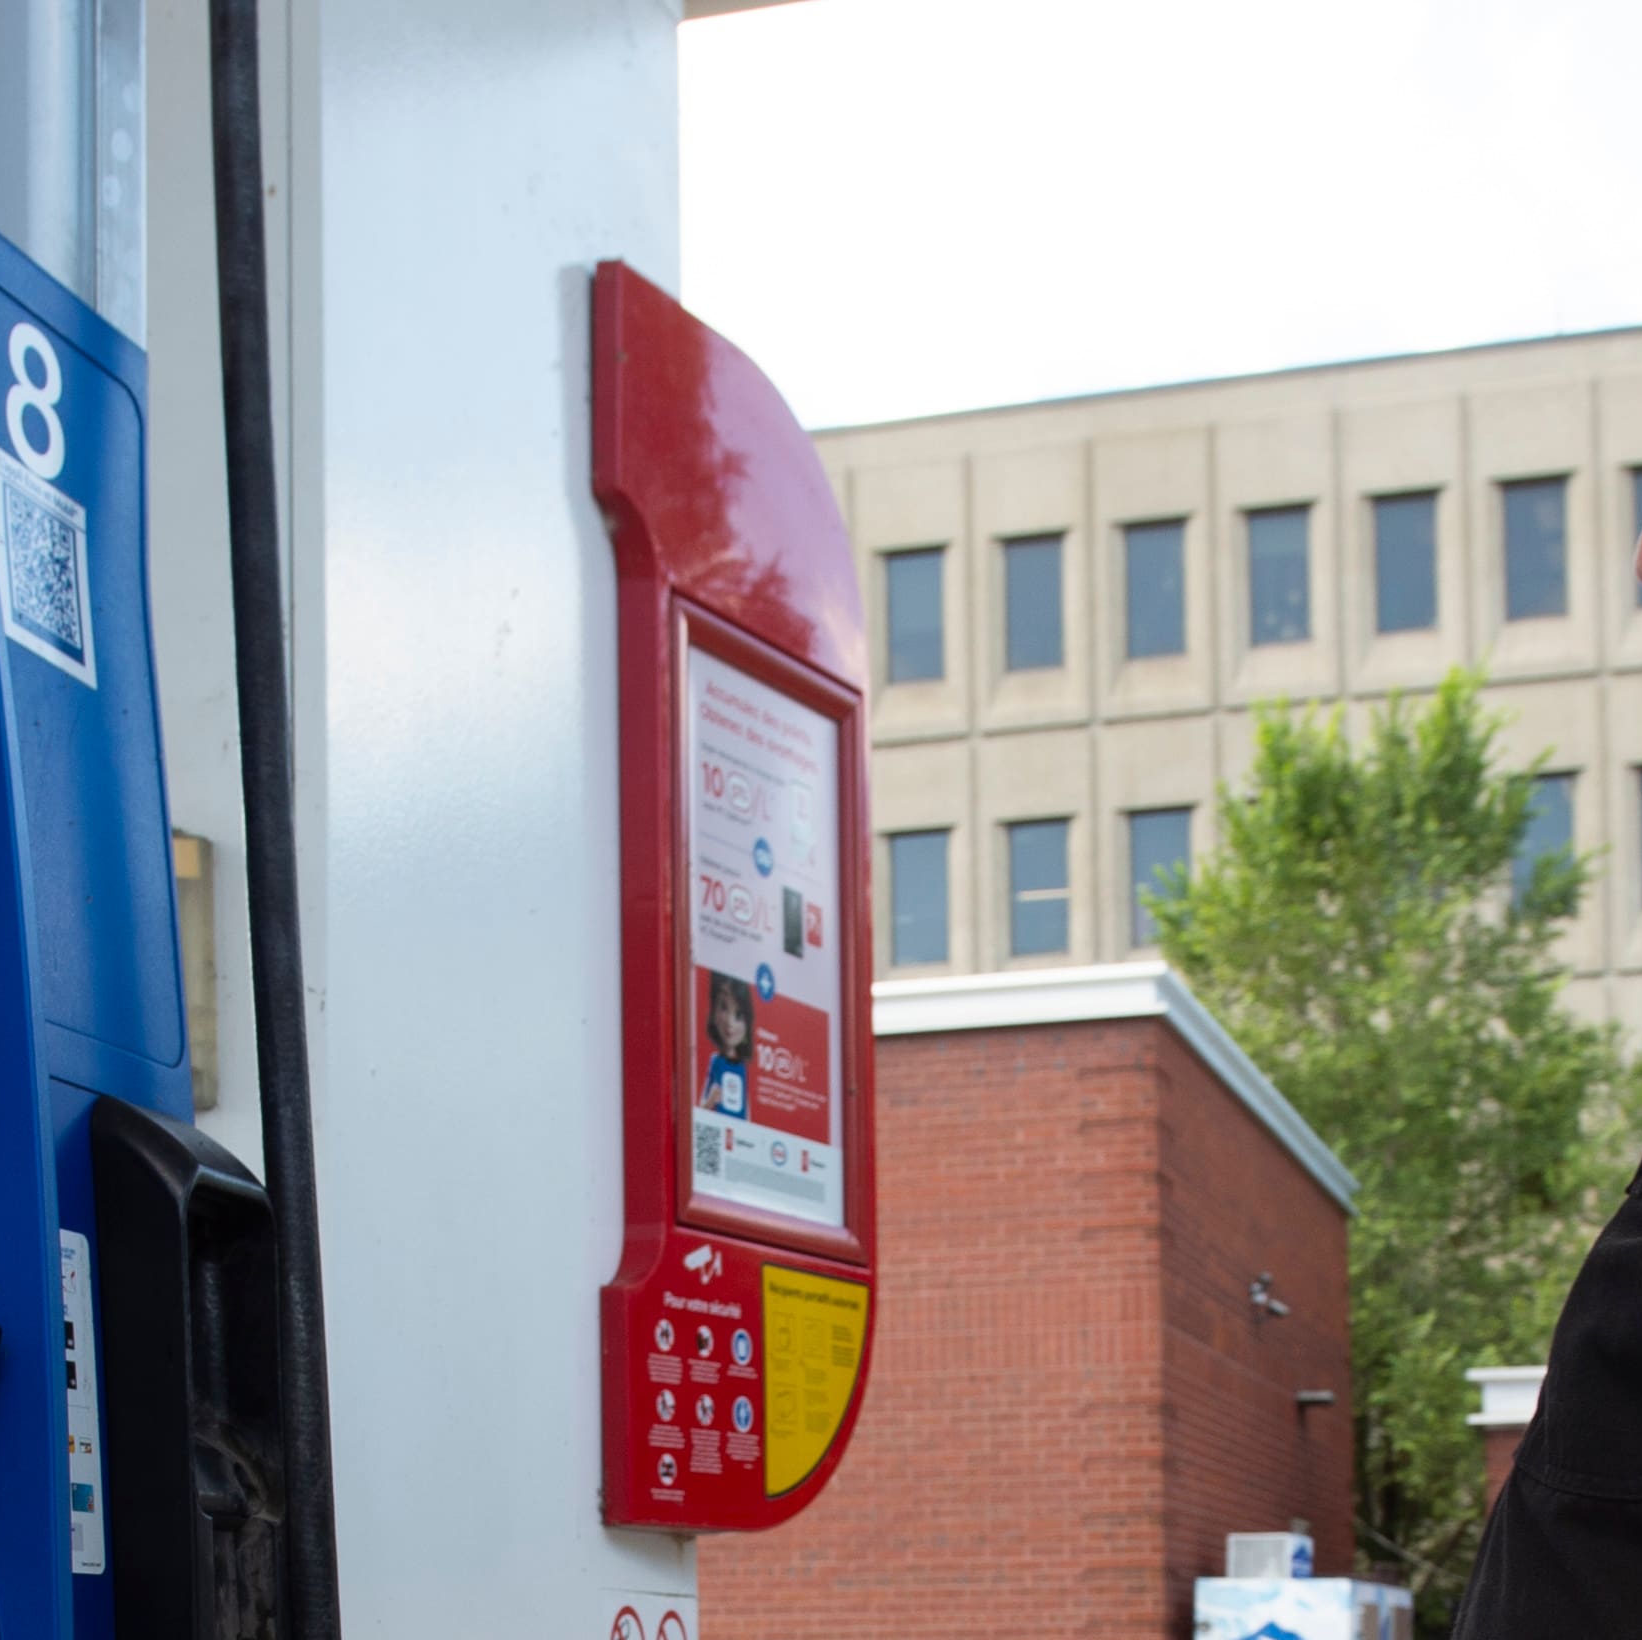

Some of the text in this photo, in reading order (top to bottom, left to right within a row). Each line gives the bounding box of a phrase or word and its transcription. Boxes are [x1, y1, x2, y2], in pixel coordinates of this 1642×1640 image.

[4, 321, 66, 481] 8
[701, 761, 724, 798] 10
[699, 873, 726, 912] 70
